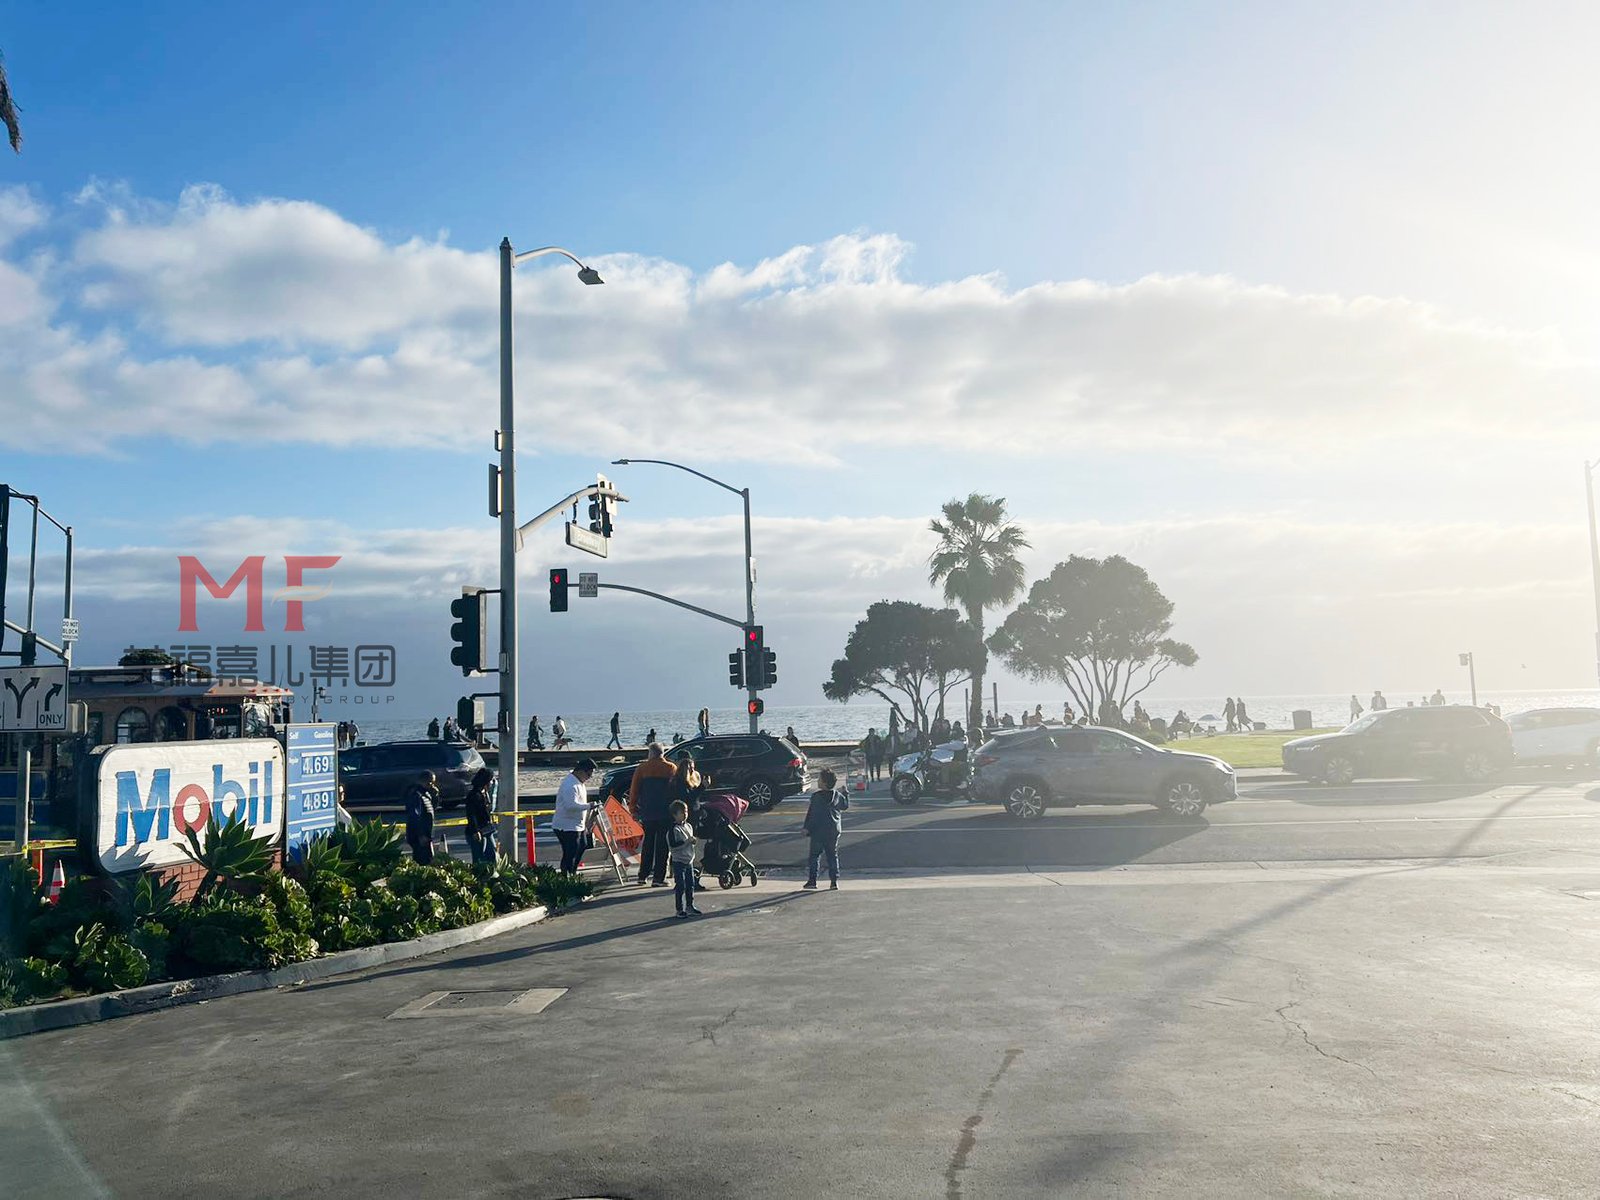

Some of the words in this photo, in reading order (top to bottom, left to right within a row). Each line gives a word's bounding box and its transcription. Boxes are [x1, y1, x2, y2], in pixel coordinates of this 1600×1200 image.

[40, 714, 63, 726] ONLY
[303, 756, 329, 774] 4.69
[115, 760, 273, 847] Mobil
[303, 791, 329, 811] 4.89
[609, 814, 628, 825] TEEL
